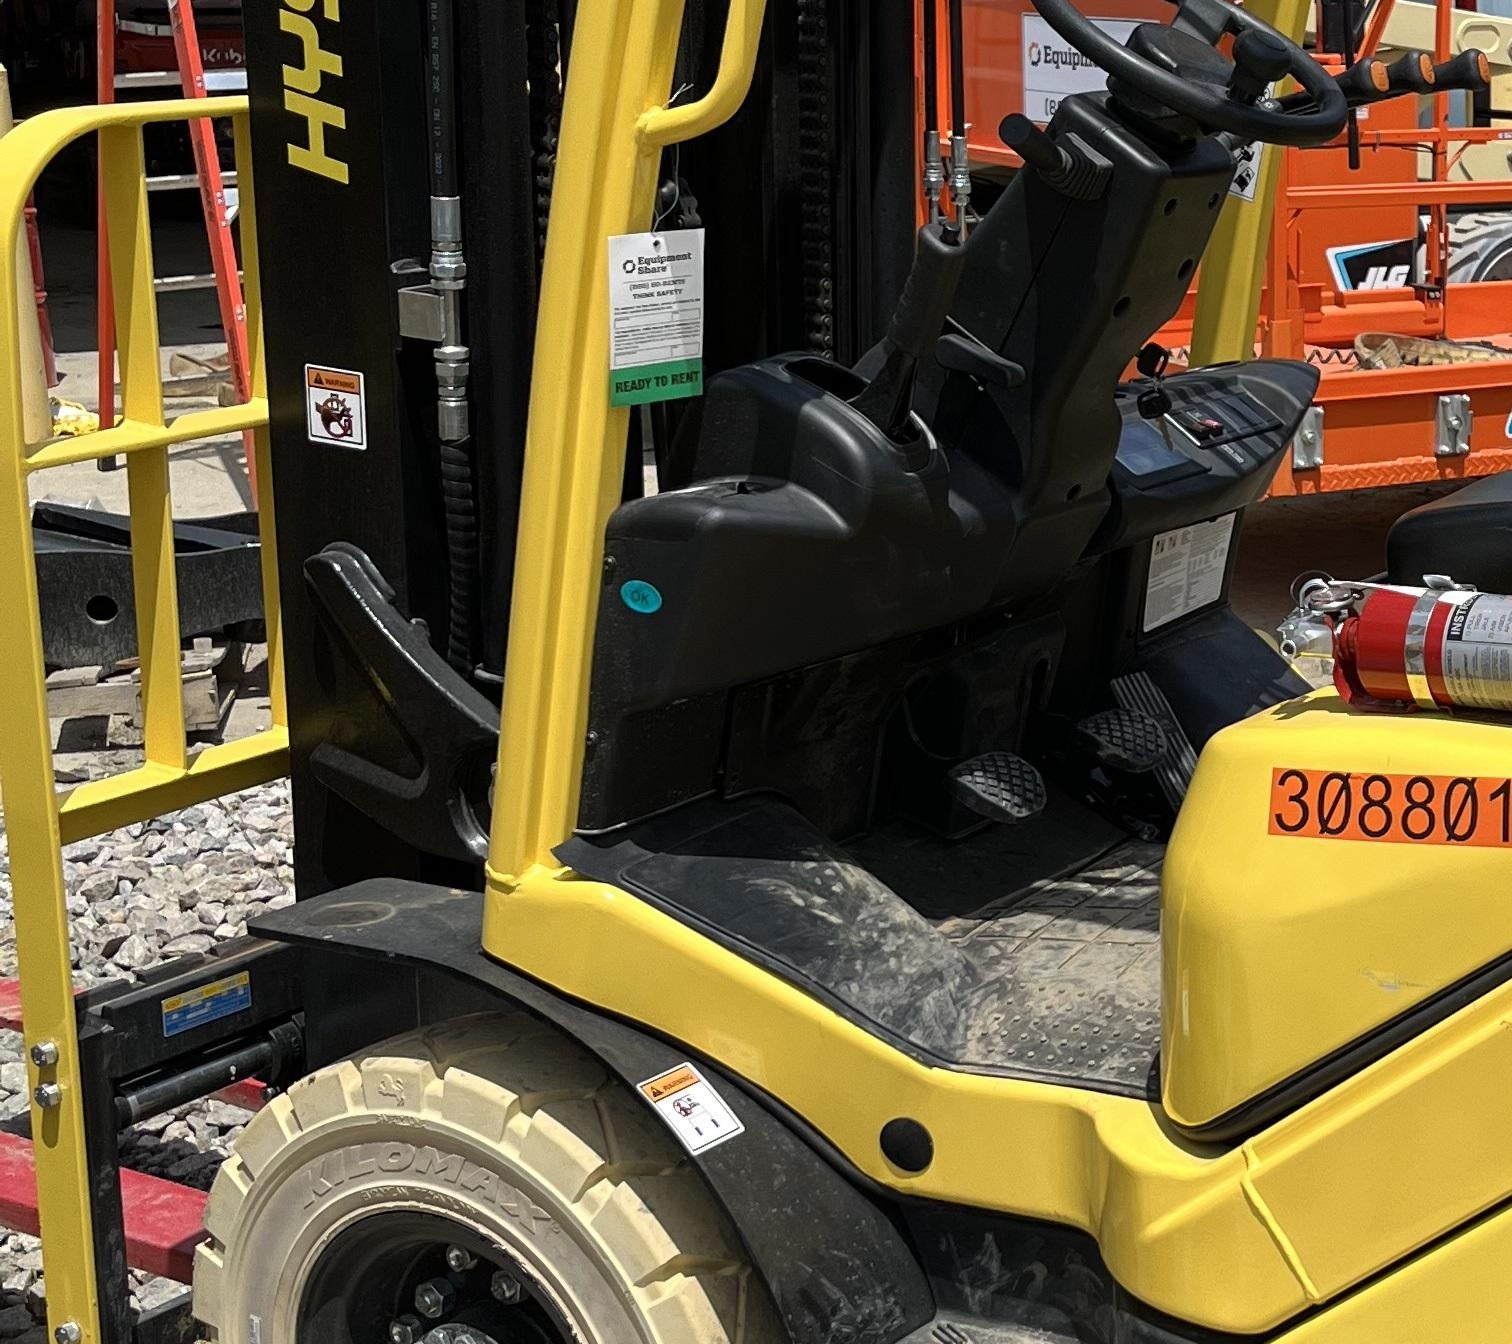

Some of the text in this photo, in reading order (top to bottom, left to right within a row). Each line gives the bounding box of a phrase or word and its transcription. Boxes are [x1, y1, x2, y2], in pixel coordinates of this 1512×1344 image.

[637, 252, 692, 267] Equipment
[637, 264, 667, 275] Share
[1357, 265, 1410, 289] JLG
[633, 288, 683, 300] THINK SAFETY
[325, 379, 355, 389] WARNING
[615, 370, 699, 394] READY TO RENT
